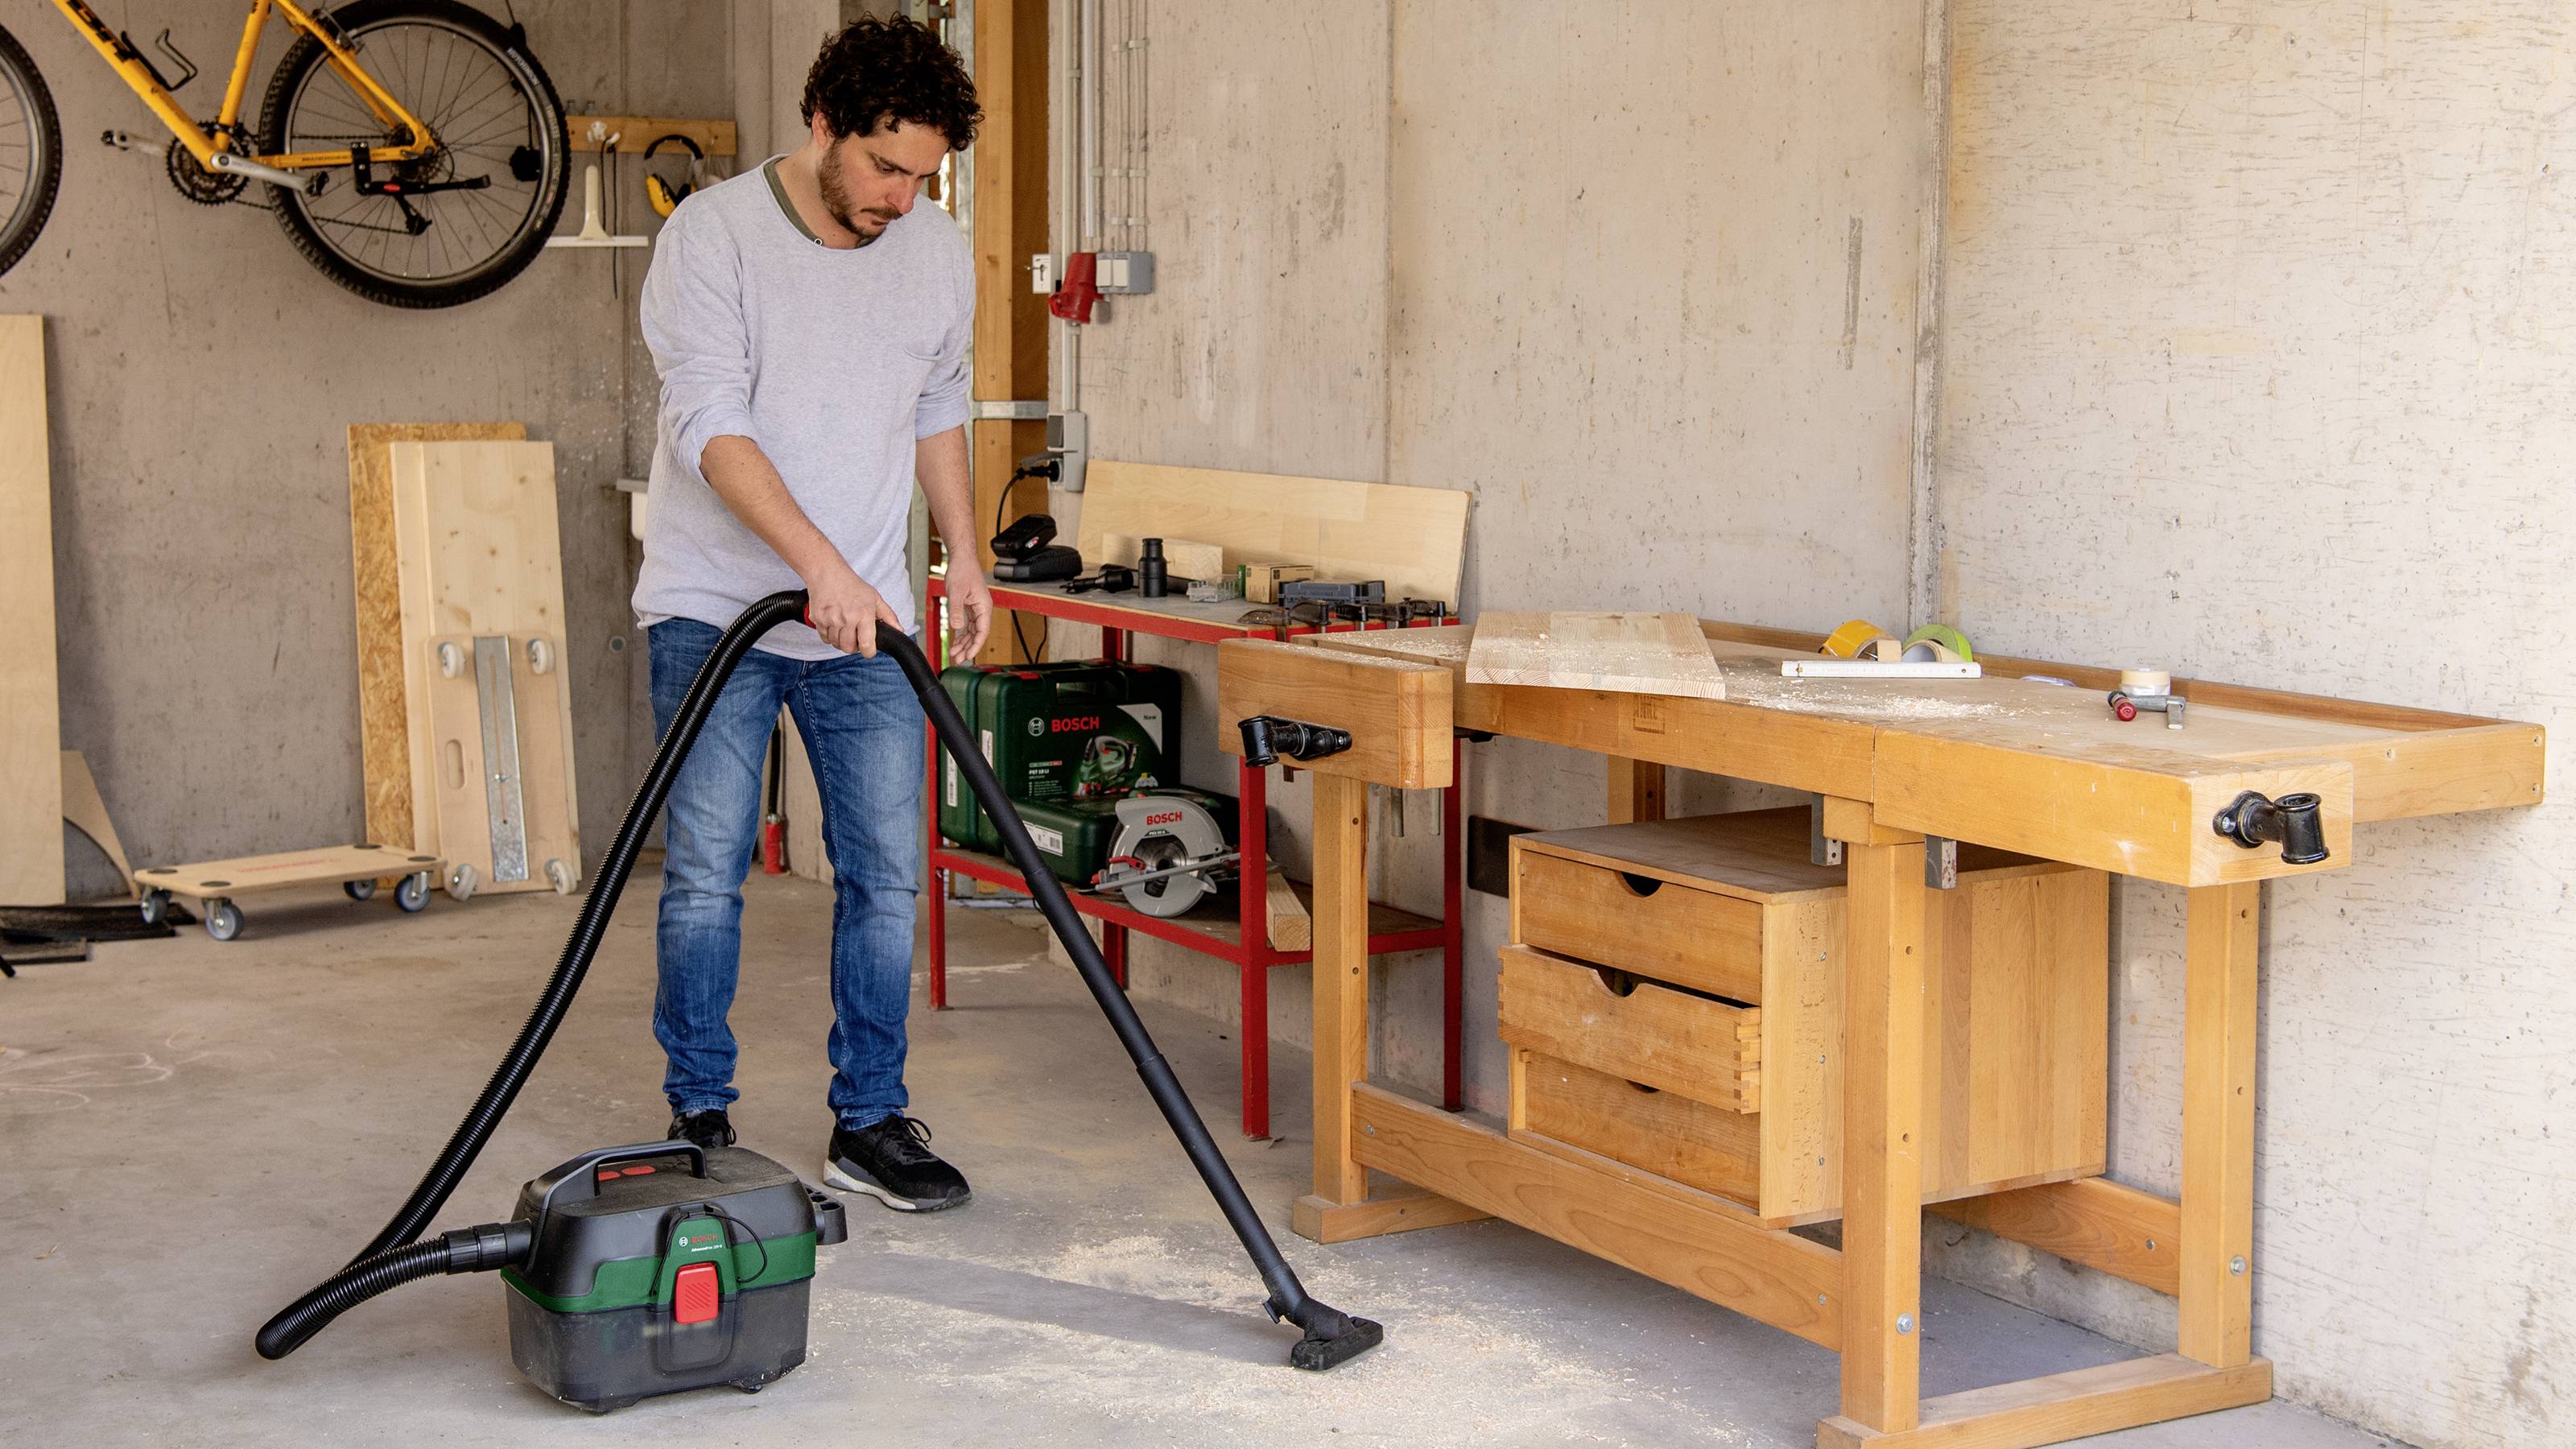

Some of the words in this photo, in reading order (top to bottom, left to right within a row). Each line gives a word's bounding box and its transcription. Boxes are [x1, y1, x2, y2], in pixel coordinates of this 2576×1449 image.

[1051, 716, 1100, 733] BOSCH
[1146, 811, 1183, 825] BOSCH
[691, 1234, 718, 1244] BOSCH
